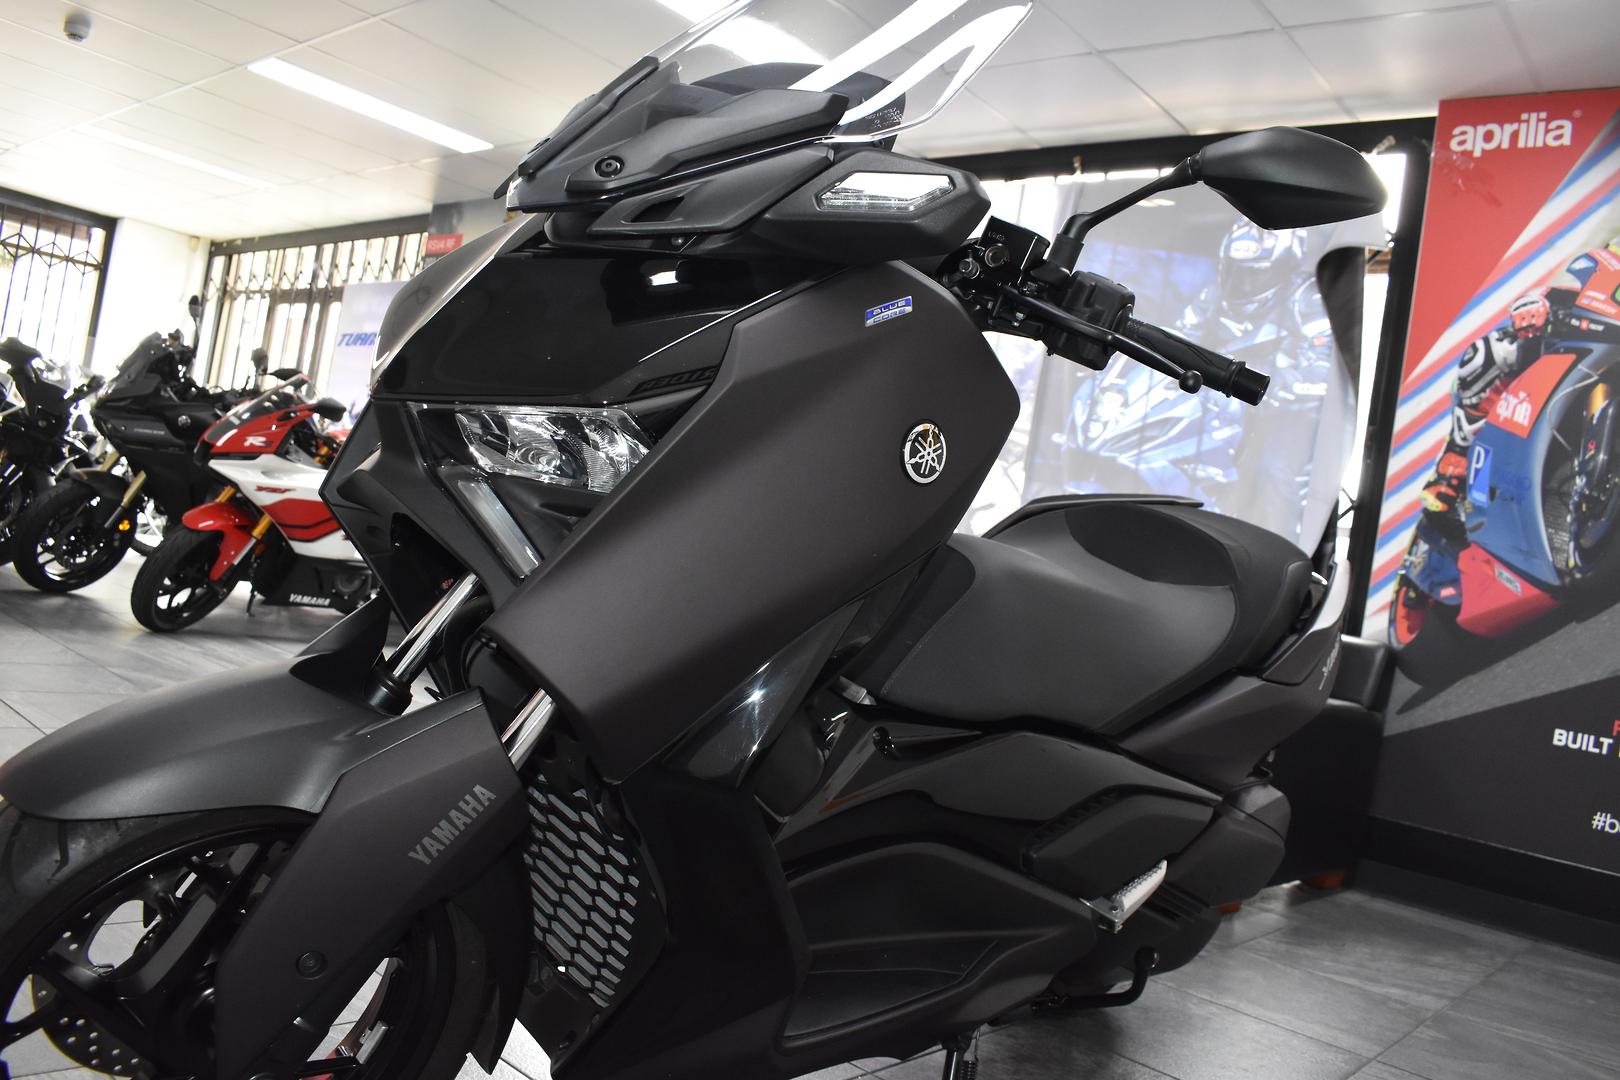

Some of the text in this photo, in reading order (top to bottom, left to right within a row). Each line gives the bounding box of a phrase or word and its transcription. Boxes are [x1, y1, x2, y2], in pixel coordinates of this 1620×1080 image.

[1449, 111, 1573, 158] aprilia
[289, 593, 331, 606] YAMAHA
[1552, 728, 1614, 755] BUILT
[407, 784, 496, 864] YAMAHA
